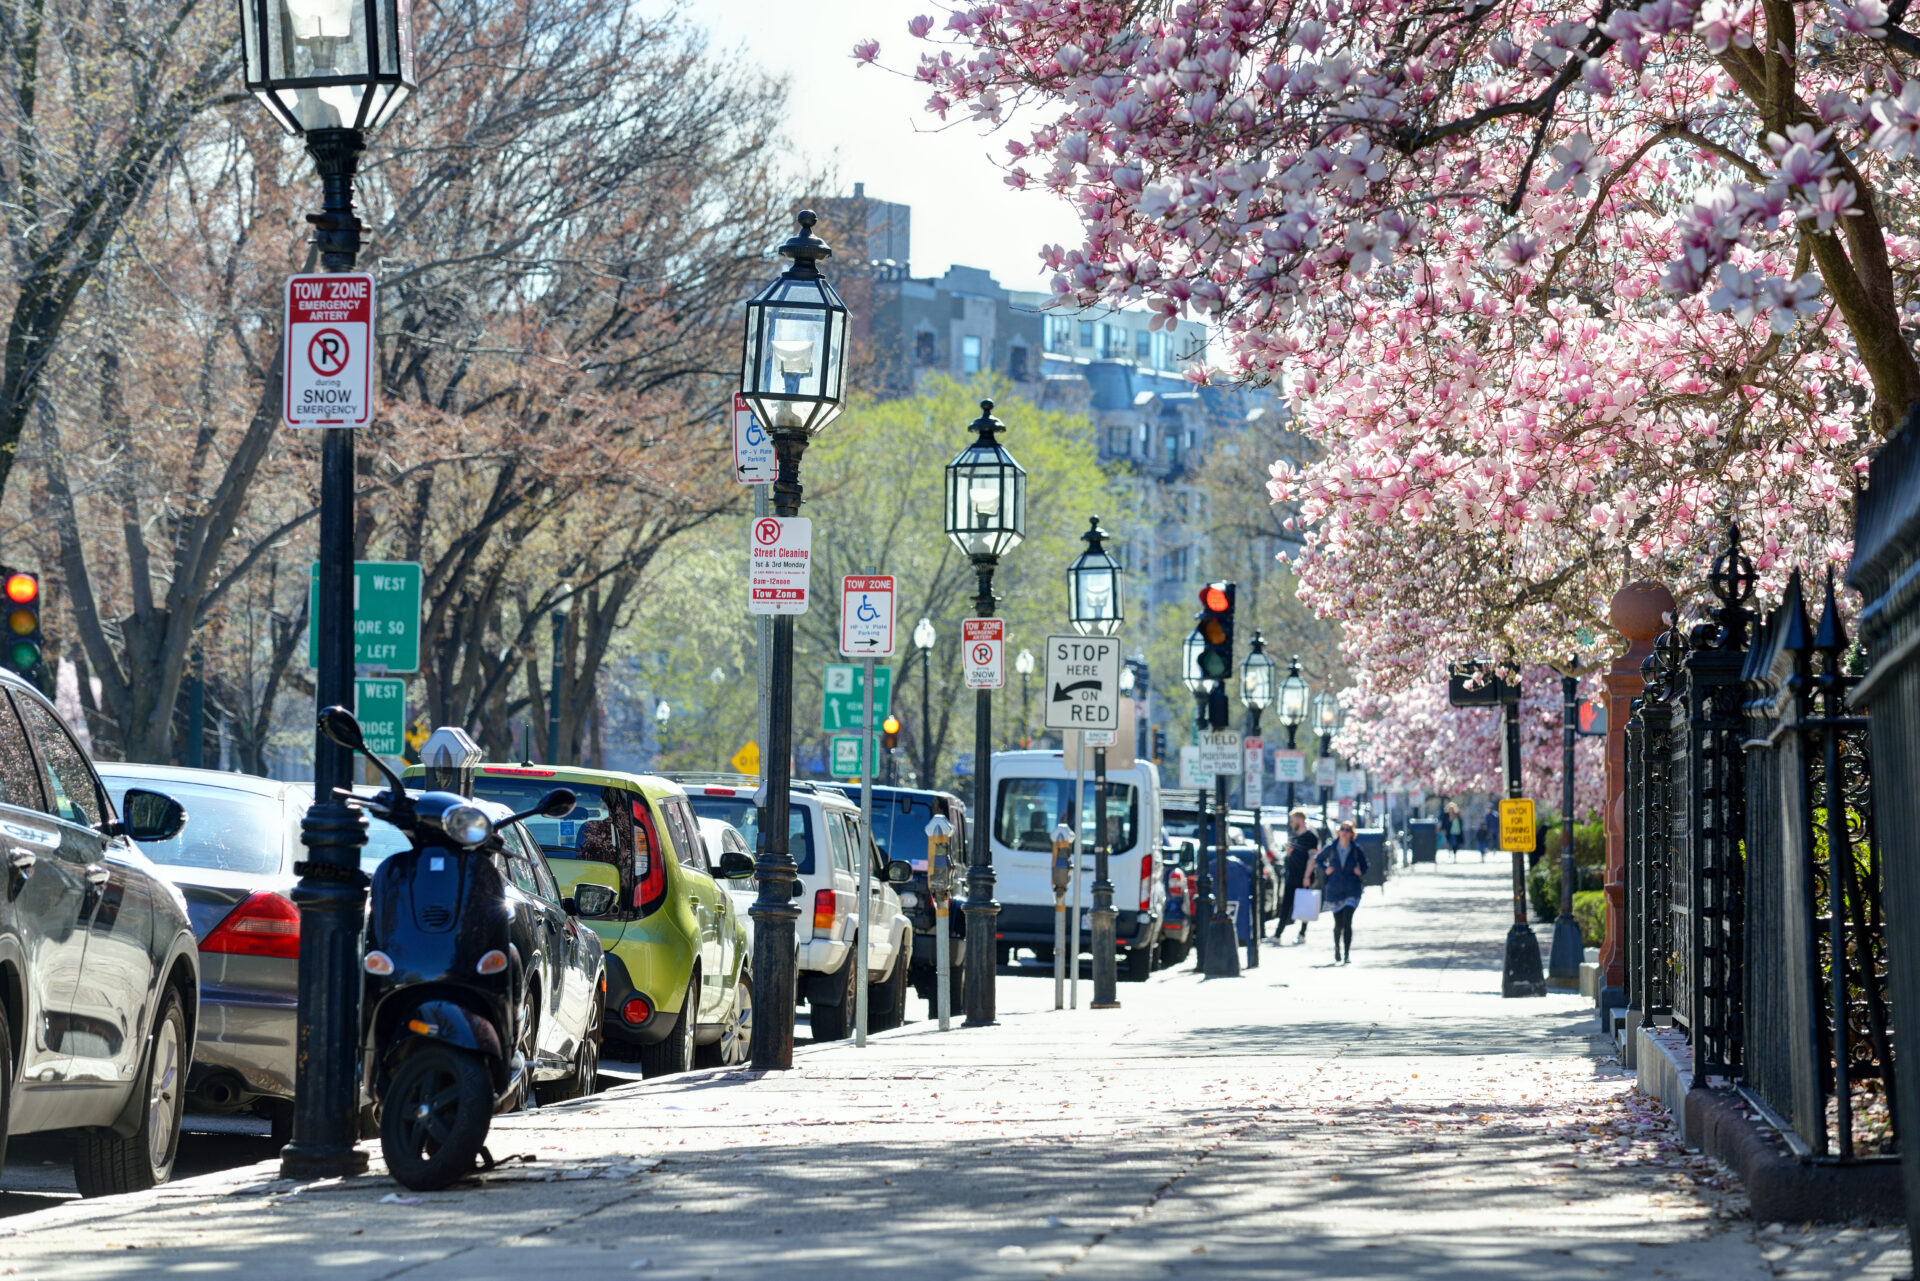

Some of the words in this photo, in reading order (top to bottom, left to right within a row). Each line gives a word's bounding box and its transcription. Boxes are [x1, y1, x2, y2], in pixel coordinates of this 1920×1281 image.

[293, 282, 323, 299] TOW
[330, 282, 367, 298] ZONE
[298, 300, 360, 310] EMERGENCY
[309, 311, 349, 320] ARTERY
[303, 389, 352, 403] SNOW
[296, 405, 357, 414] EMERGENCY
[754, 547, 776, 558] Street
[778, 547, 809, 559] Cleaning
[783, 561, 806, 569] Monday
[373, 575, 406, 591] WEST
[847, 580, 865, 589] TOW
[869, 580, 891, 589] ZONE
[755, 589, 772, 598] Tow
[775, 589, 797, 598] Zone
[982, 622, 1001, 630] ZONE
[367, 645, 396, 659] LEFT
[1057, 644, 1110, 662] STOP
[1066, 665, 1099, 676] HERE
[834, 672, 845, 688] 2
[365, 683, 398, 698] WEST
[1081, 691, 1098, 701] ON
[1071, 705, 1110, 722] RED
[1203, 734, 1237, 745] YIELD
